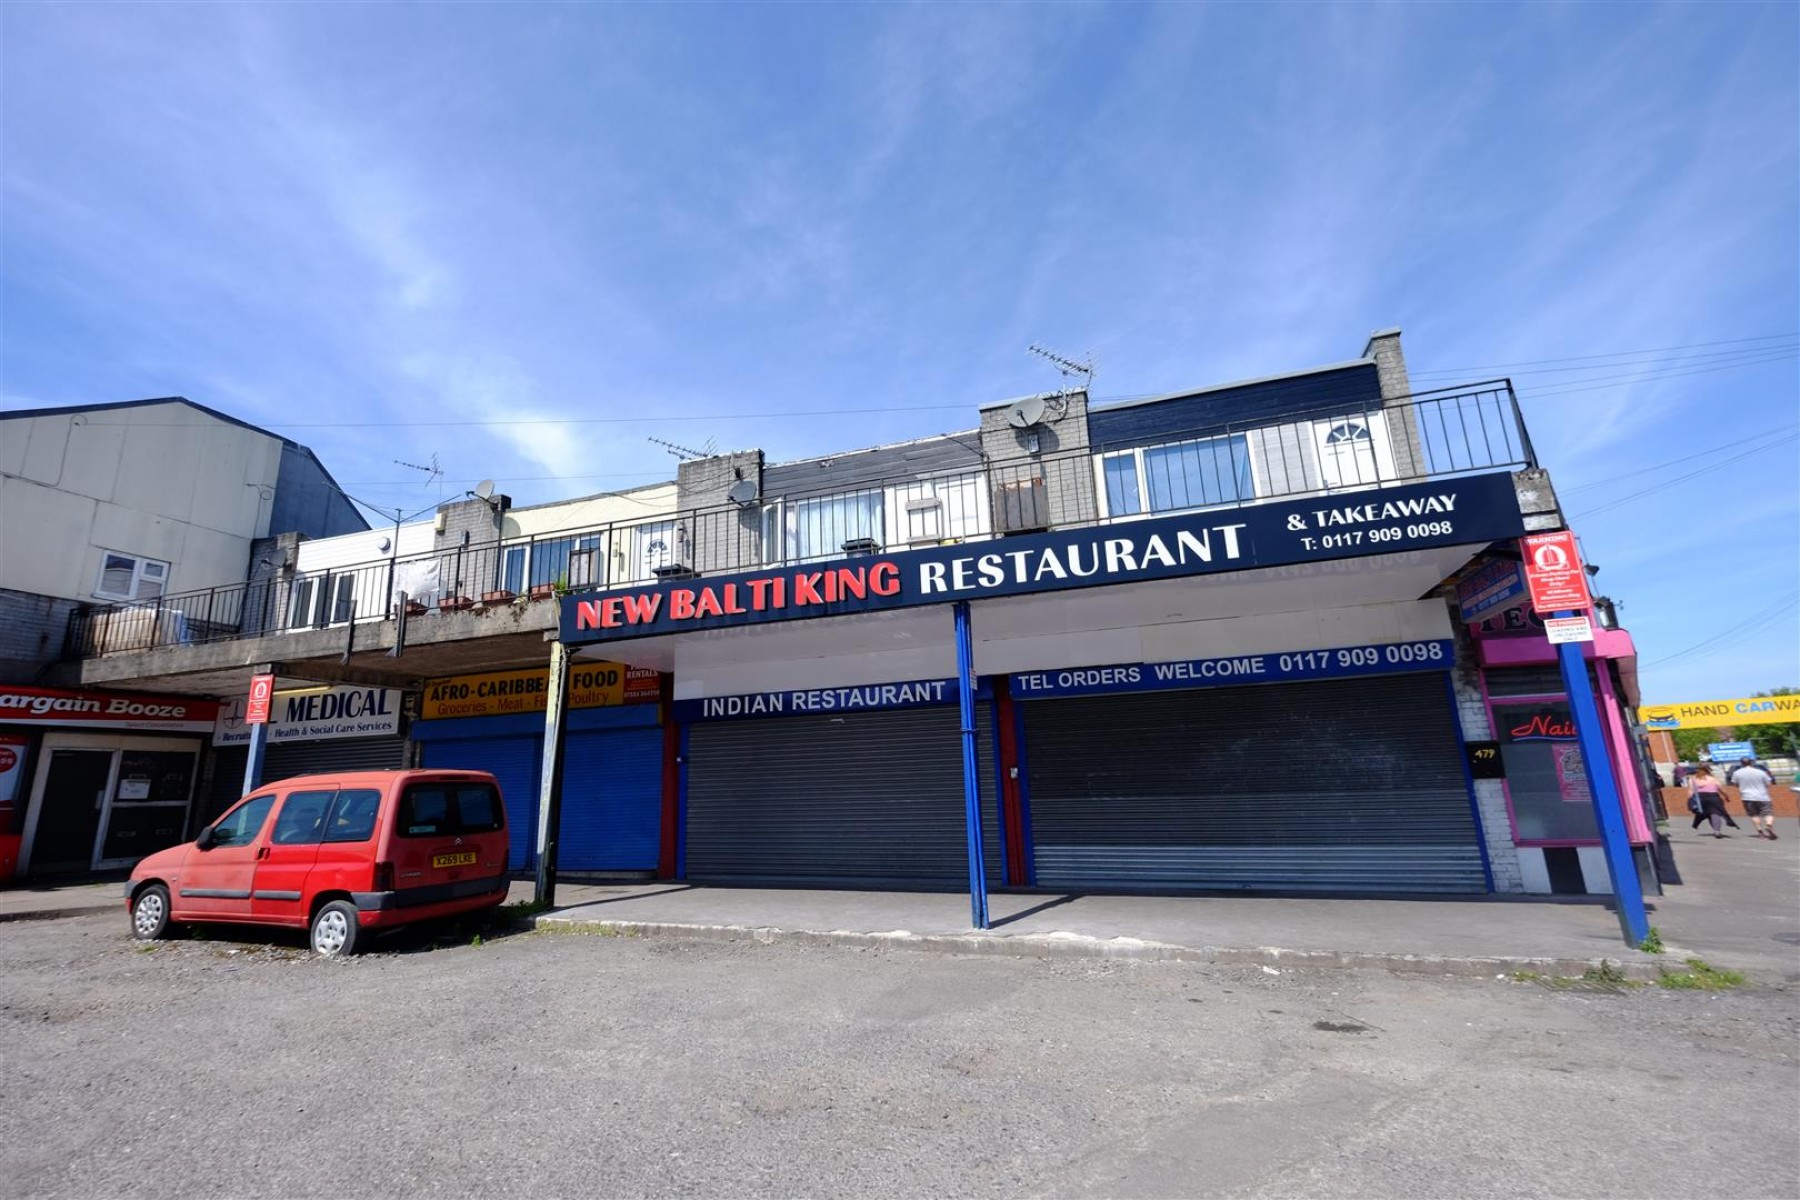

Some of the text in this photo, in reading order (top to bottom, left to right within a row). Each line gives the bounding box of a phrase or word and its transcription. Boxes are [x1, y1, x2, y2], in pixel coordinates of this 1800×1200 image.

[1287, 494, 1456, 531] & TAKEAWAY
[1301, 520, 1453, 551] T: 0117 909 0098
[577, 523, 1247, 630] NEW BALTI KING RESTAURANT
[1018, 642, 1444, 691] TEL ORDERS WELCOME 0117 909 0098
[431, 677, 549, 702] AFRO-CARIBBE
[573, 670, 619, 690] FOOD
[703, 681, 946, 718] INDIAN RESTAURANT
[105, 699, 186, 718] Booze
[286, 688, 392, 722] MEDICAL
[438, 702, 487, 715] Groceries
[498, 698, 523, 711] Meat
[1680, 704, 1730, 717] HAND
[274, 728, 300, 739] Health
[302, 727, 307, 736] &
[310, 724, 334, 735] Social
[336, 723, 355, 734] Care
[357, 721, 392, 732] Services
[1474, 749, 1495, 759] 479
